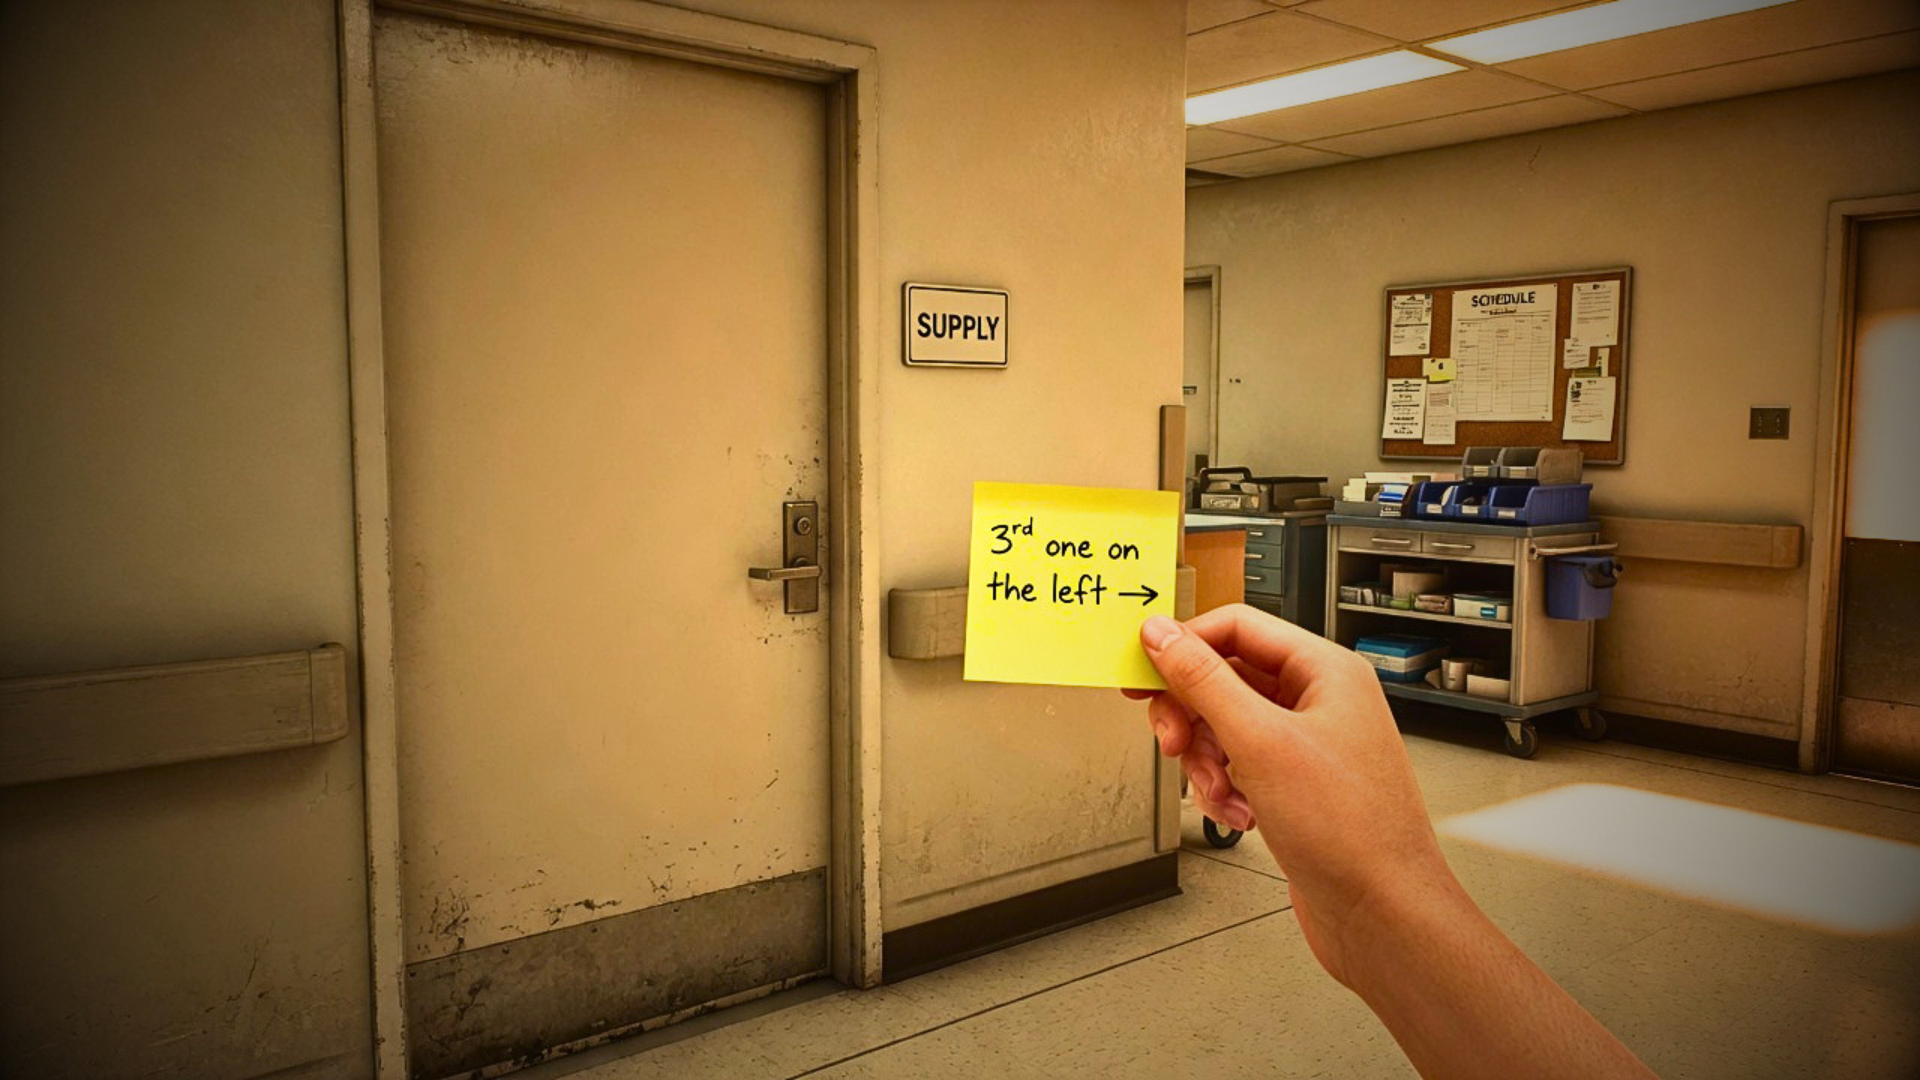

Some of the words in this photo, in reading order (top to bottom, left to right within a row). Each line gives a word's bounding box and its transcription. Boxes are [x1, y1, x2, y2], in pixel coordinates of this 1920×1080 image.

[917, 312, 1000, 341] SUPPLY
[990, 516, 1034, 555] 3rd
[1045, 540, 1094, 559] one
[1108, 543, 1140, 561] on
[986, 571, 1037, 601] the
[1052, 572, 1108, 605] left
